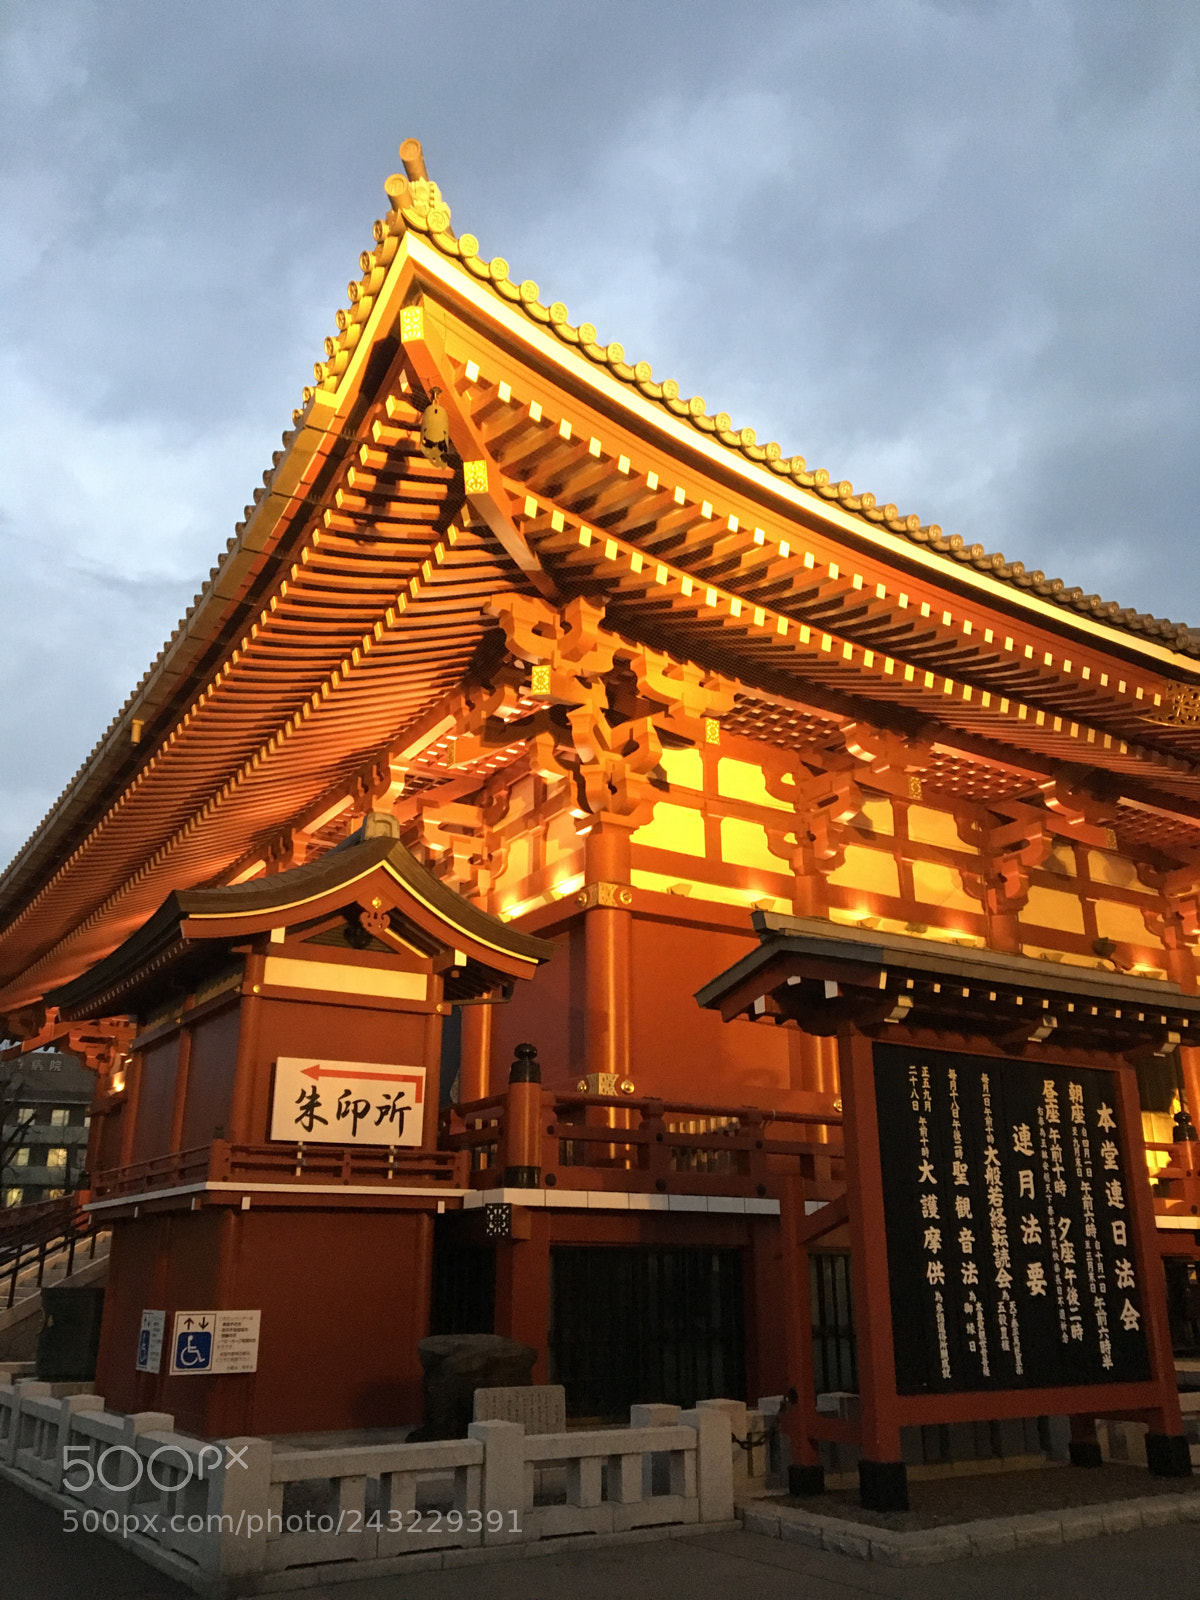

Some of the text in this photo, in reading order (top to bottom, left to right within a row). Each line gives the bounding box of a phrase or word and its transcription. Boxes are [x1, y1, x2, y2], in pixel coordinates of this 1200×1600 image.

[295, 1085, 412, 1138] 朱印所
[908, 1065, 920, 1112] 二十八日
[921, 1065, 932, 1113] 正五九月
[1068, 1081, 1086, 1124] 朝座
[917, 1158, 946, 1286] 大護摩供
[1012, 1122, 1048, 1297] 連月法要
[1081, 1180, 1097, 1239] 午前六時
[1096, 1101, 1140, 1331] 本堂連日法会
[1093, 1295, 1114, 1371] 午前六時半
